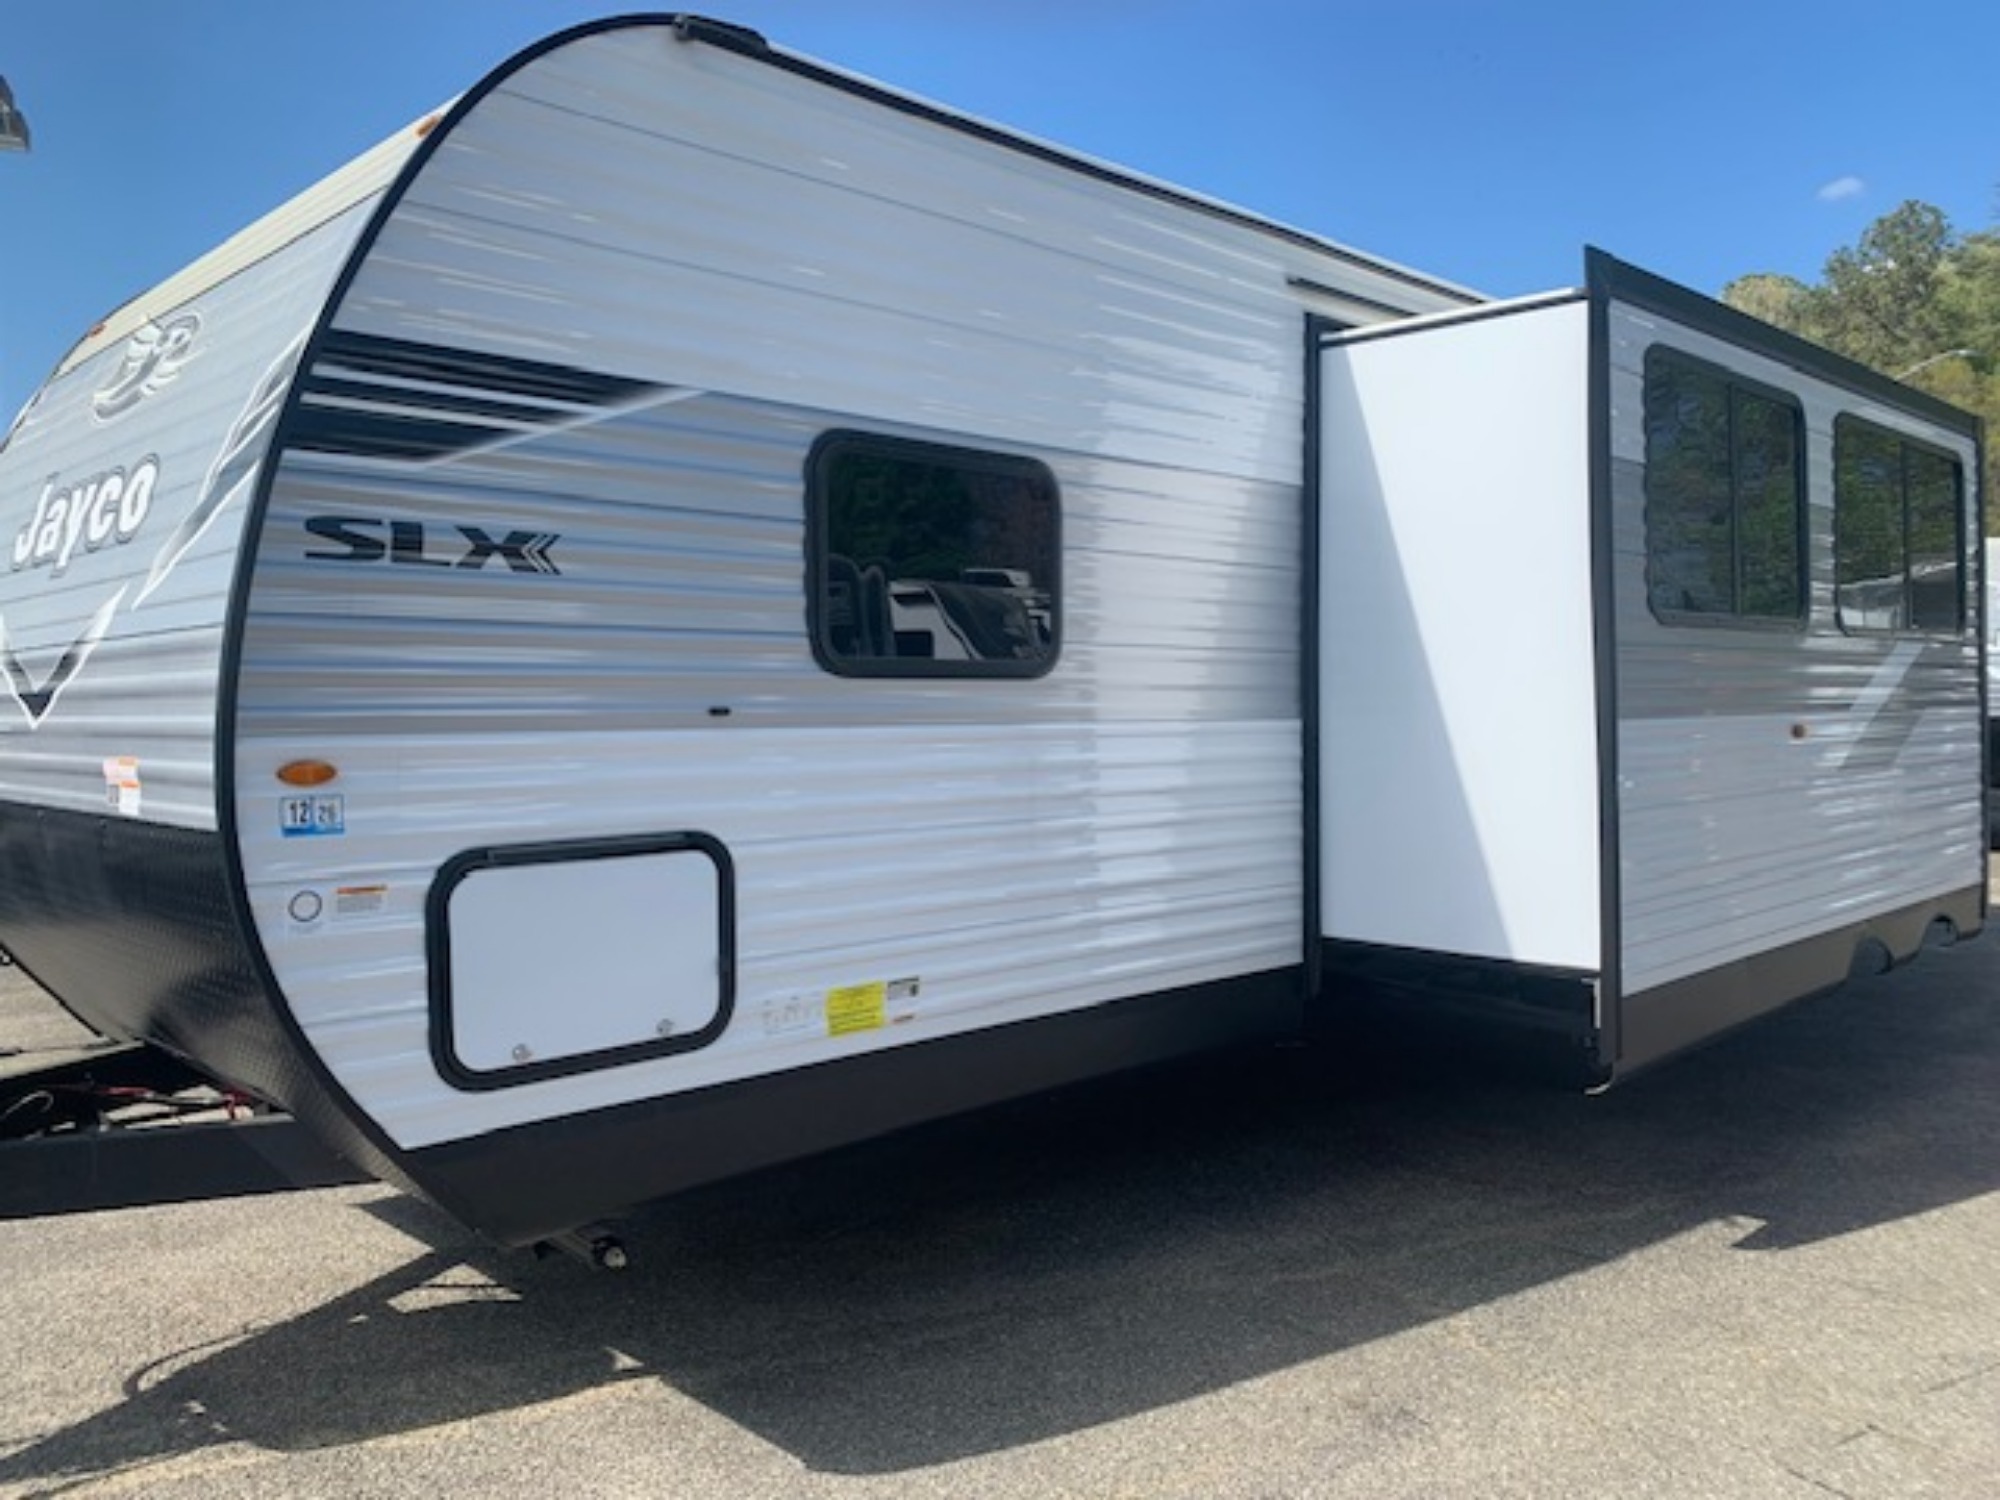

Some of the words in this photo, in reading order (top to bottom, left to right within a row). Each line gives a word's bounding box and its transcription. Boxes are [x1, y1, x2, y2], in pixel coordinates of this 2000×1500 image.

[11, 454, 160, 578] Jayco
[304, 515, 562, 575] SLX
[289, 801, 308, 824] 12
